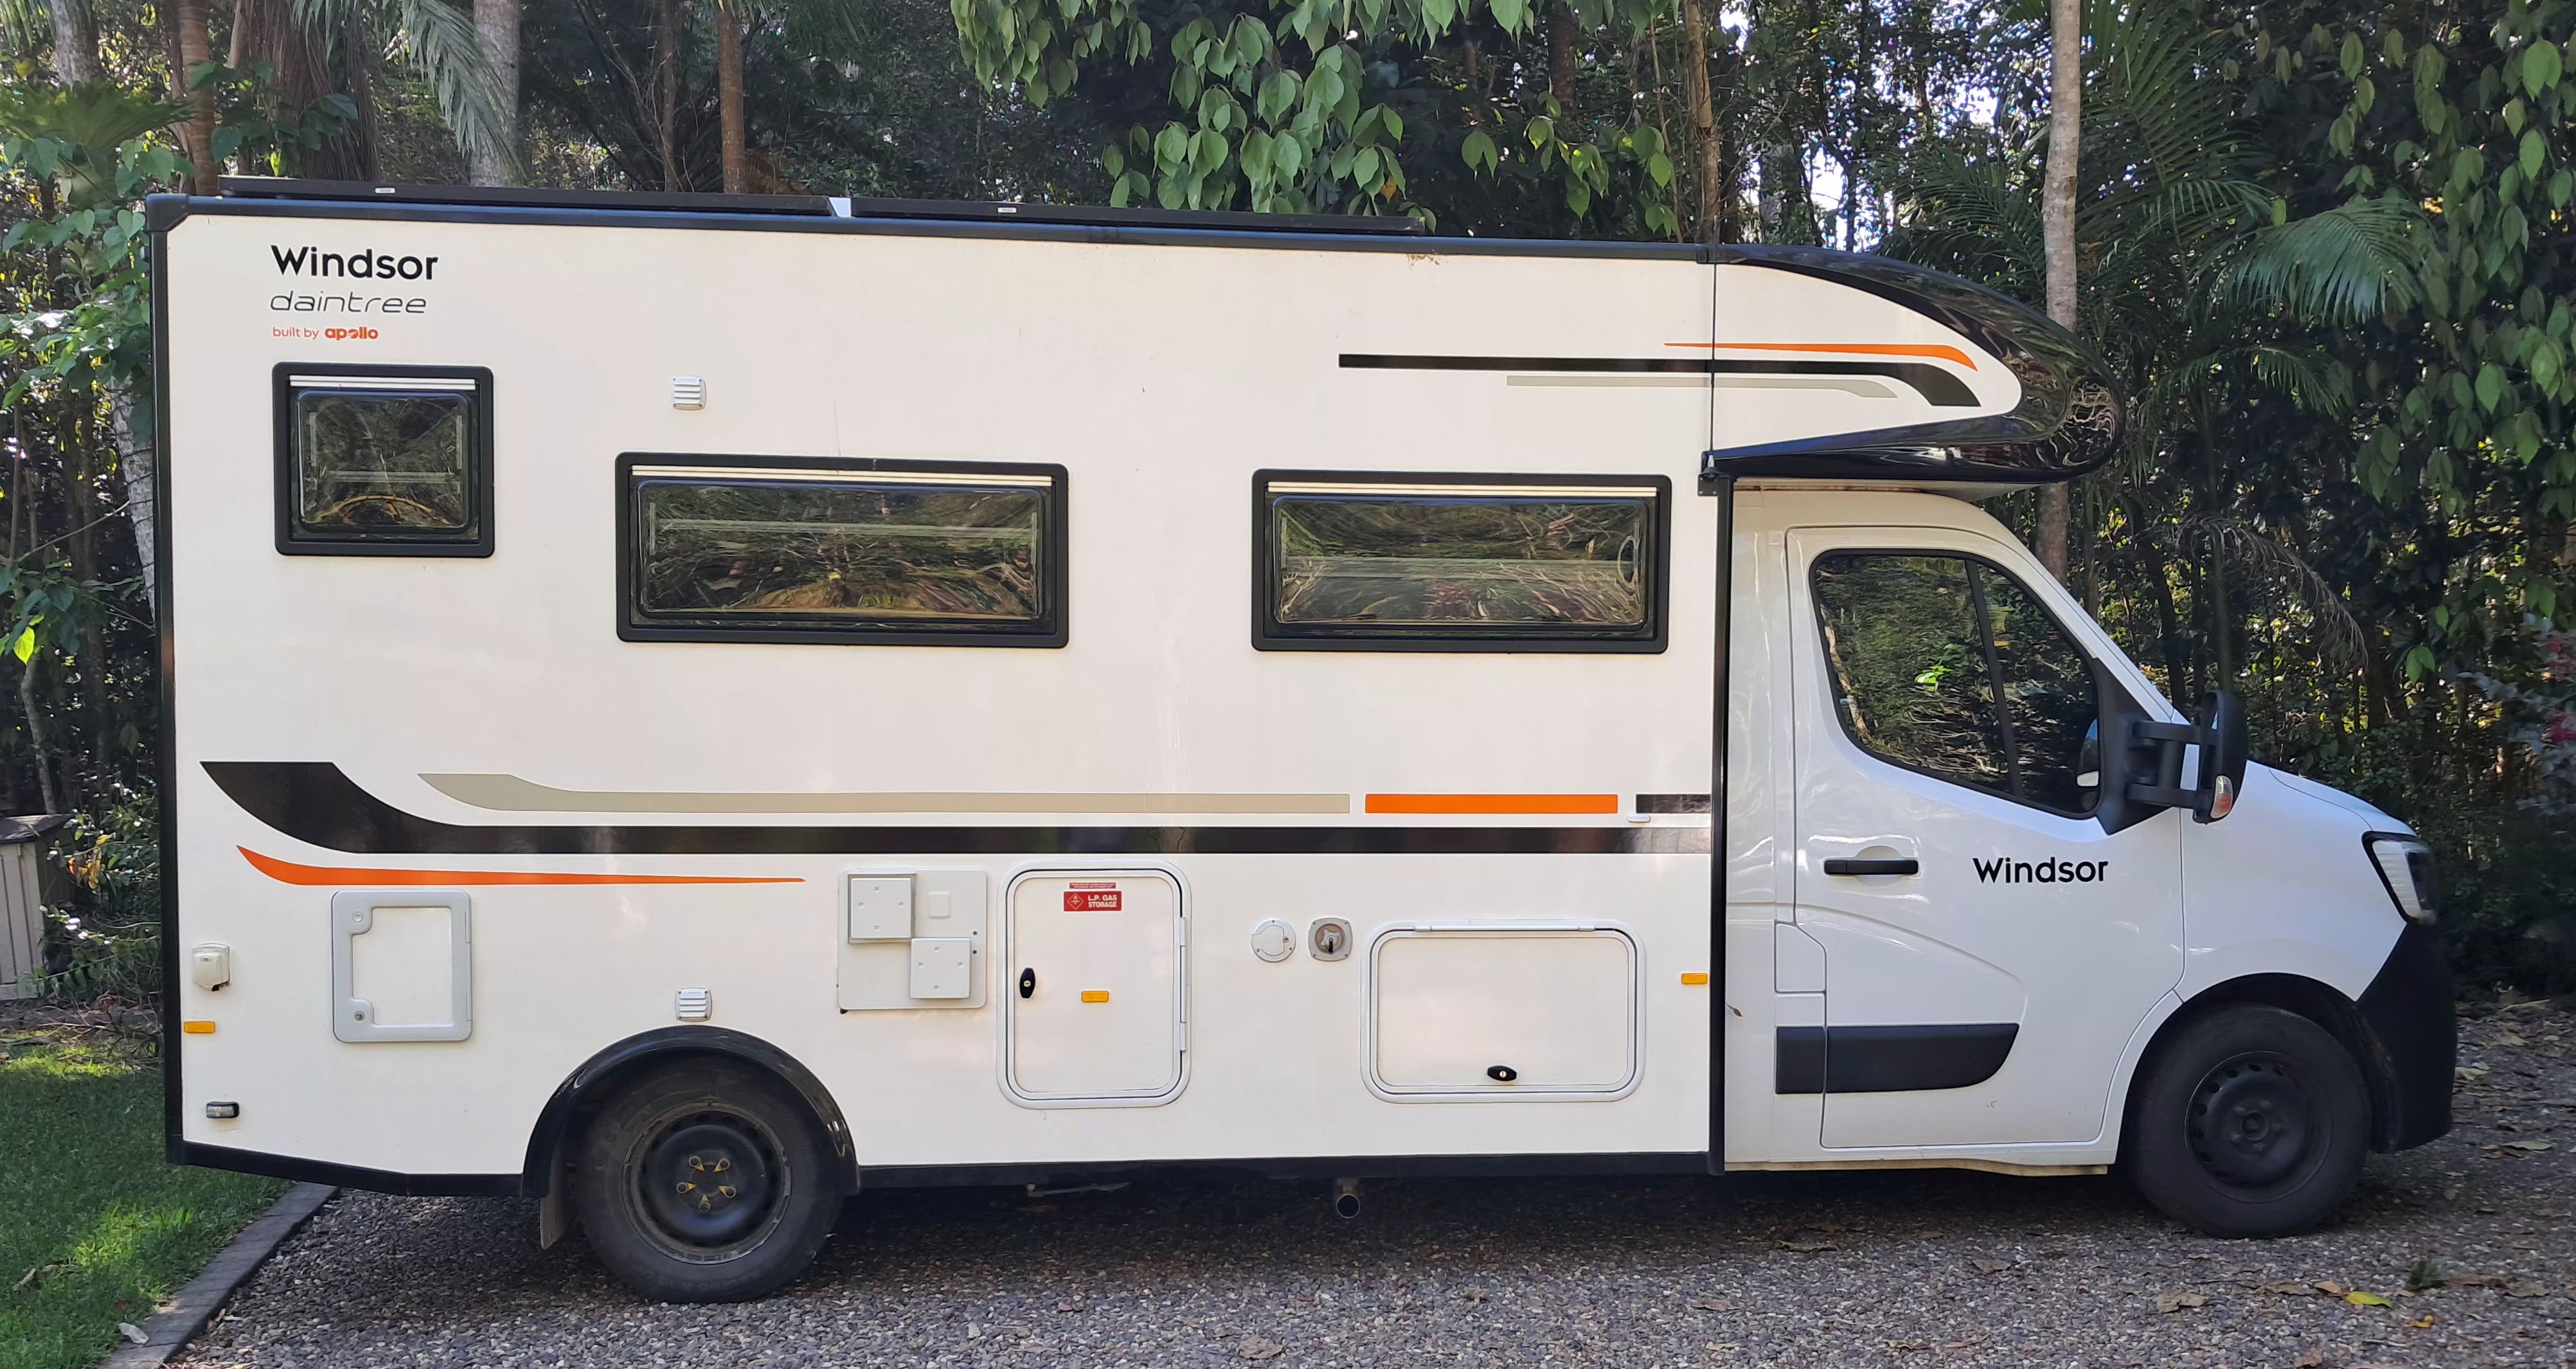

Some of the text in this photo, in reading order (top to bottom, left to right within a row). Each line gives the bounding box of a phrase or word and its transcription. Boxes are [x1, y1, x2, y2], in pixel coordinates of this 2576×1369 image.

[270, 244, 439, 280] Windsor
[270, 290, 427, 314] daintree
[273, 327, 379, 341] built by apollo
[1972, 856, 2109, 884] Windsor
